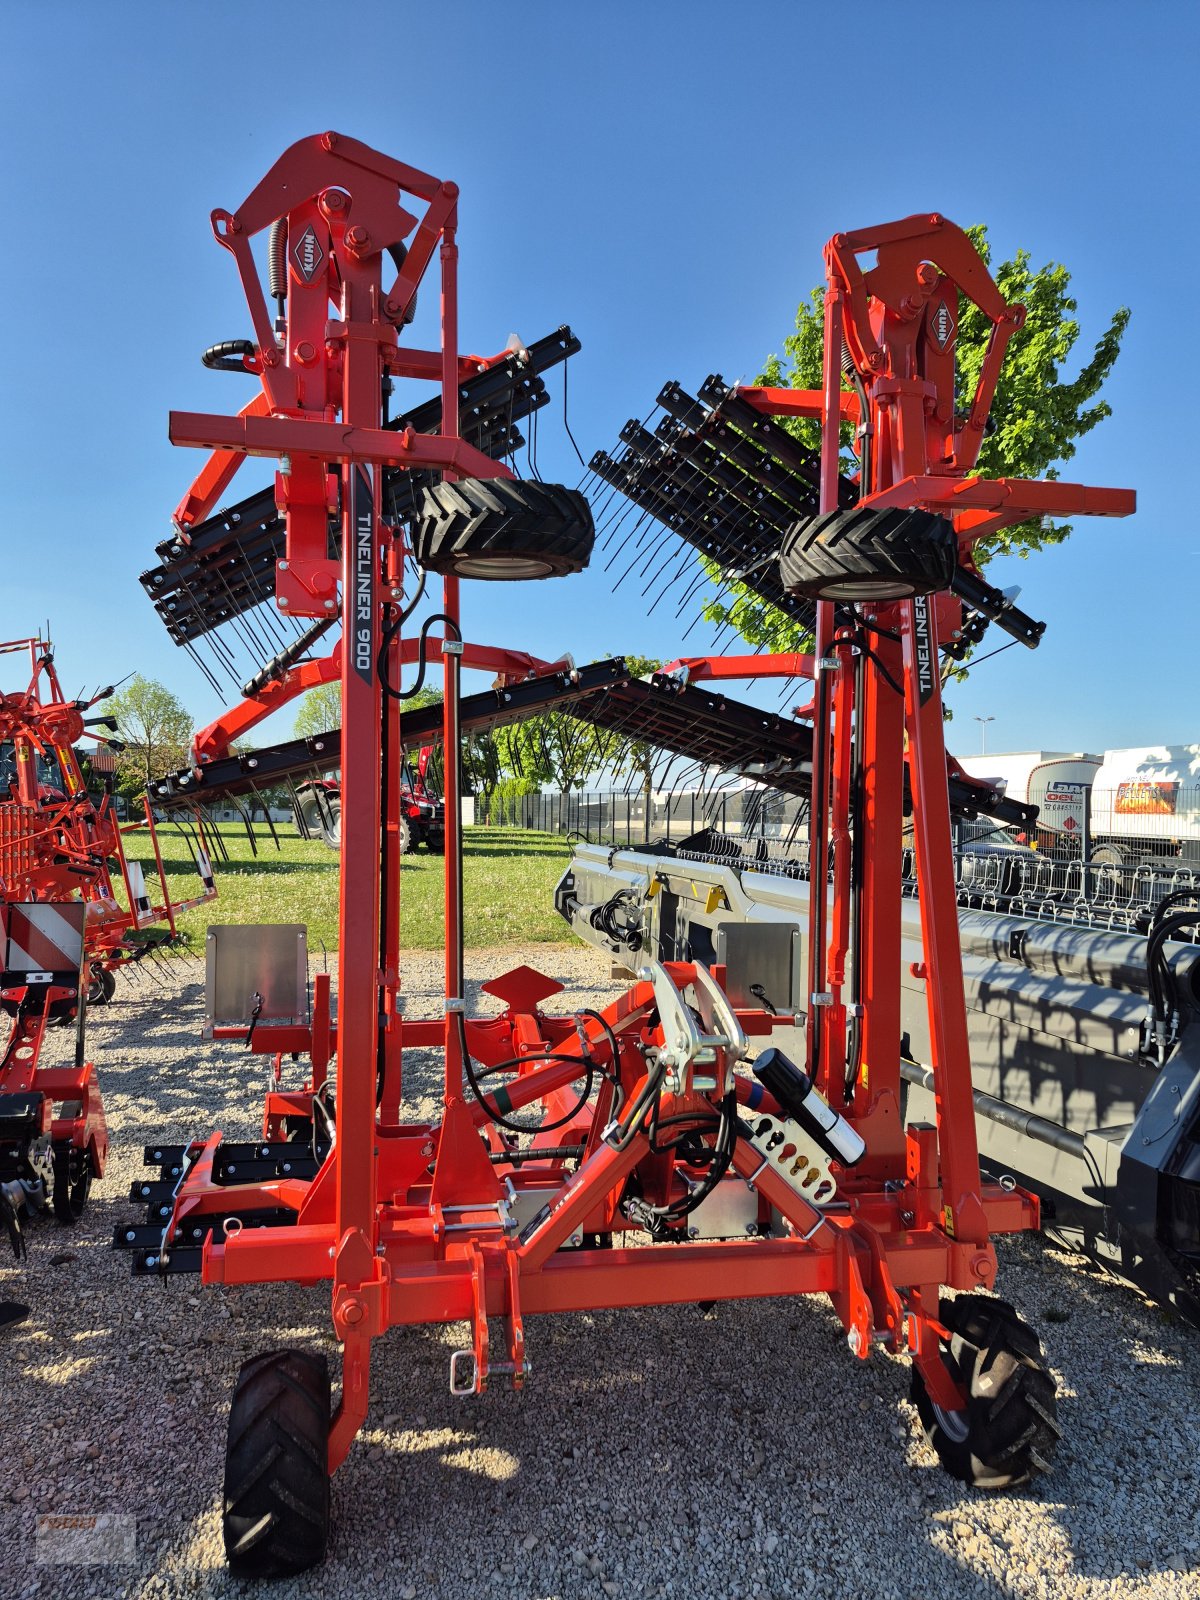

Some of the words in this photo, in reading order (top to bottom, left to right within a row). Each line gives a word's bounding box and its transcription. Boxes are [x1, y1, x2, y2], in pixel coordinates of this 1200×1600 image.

[303, 234, 315, 272] KUHN
[938, 308, 947, 341] KUHN
[357, 513, 372, 620] TINELINER
[356, 628, 371, 670] 900
[915, 595, 932, 693] TINELINER
